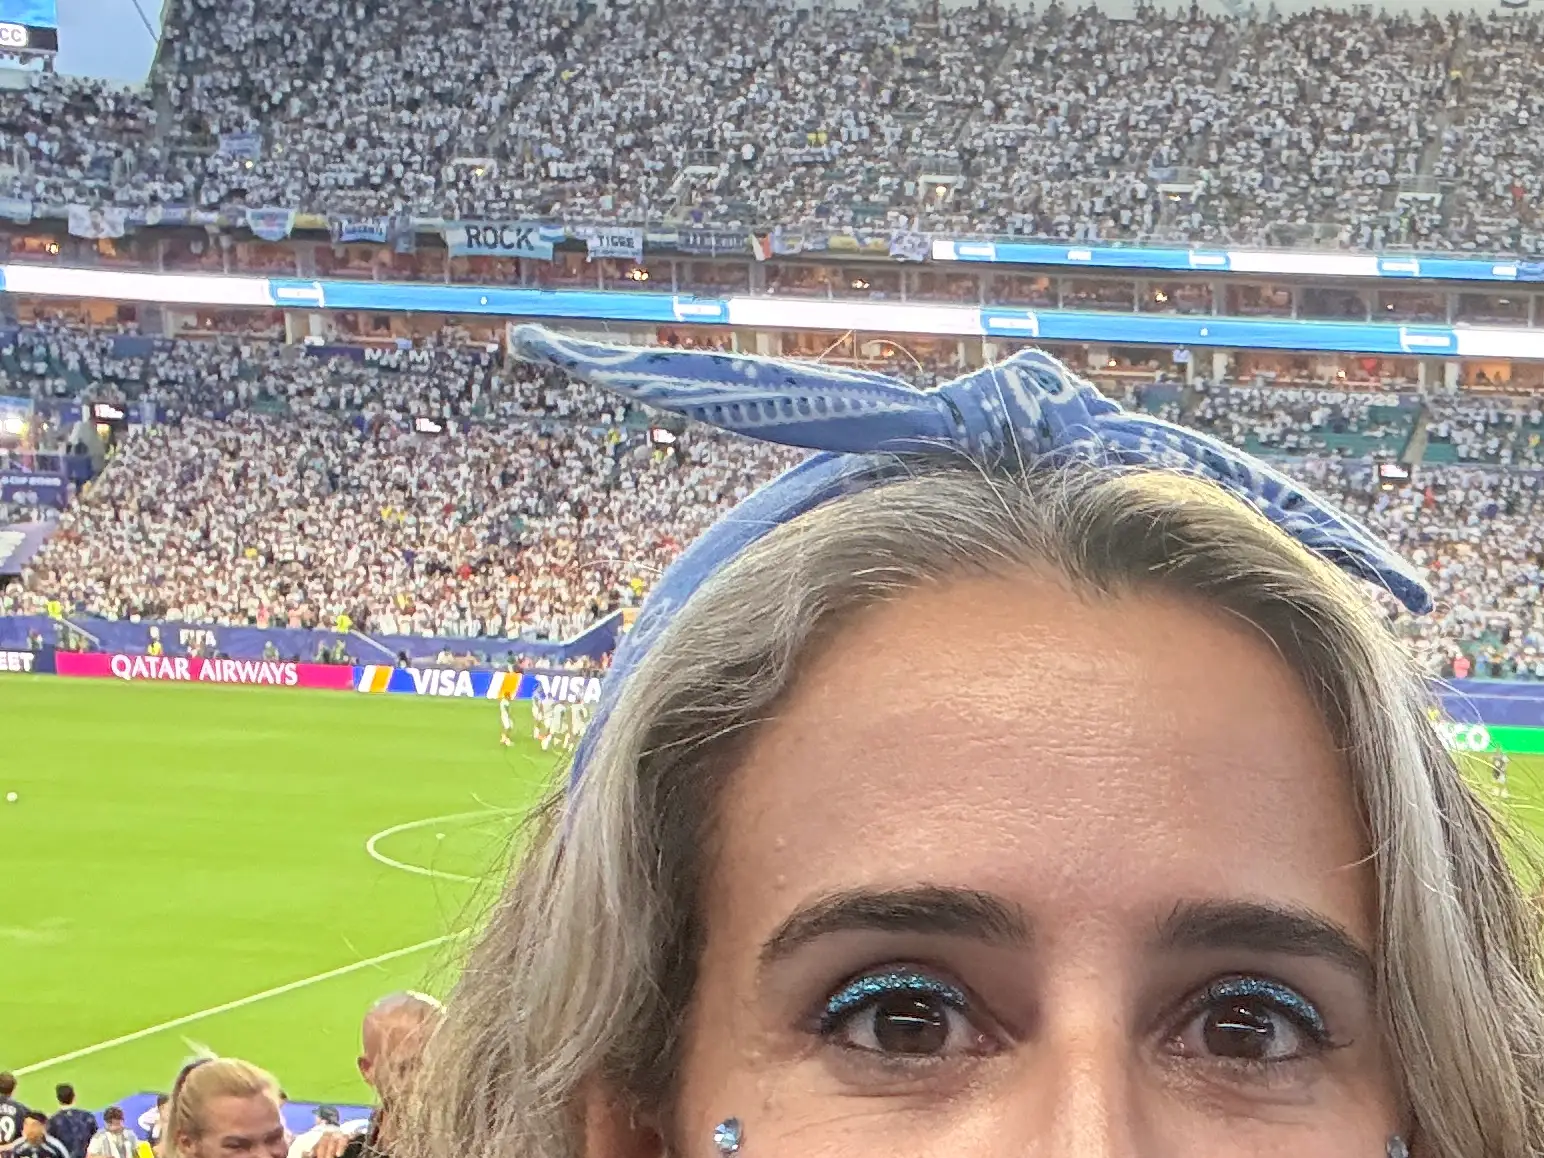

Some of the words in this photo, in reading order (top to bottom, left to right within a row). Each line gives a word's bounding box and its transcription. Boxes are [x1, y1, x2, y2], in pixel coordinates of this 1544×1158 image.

[465, 224, 535, 252] ROCK
[110, 653, 191, 682] QATAR
[199, 658, 298, 686] AIRWAYS
[412, 667, 475, 697] VISA
[534, 673, 602, 703] VISA
